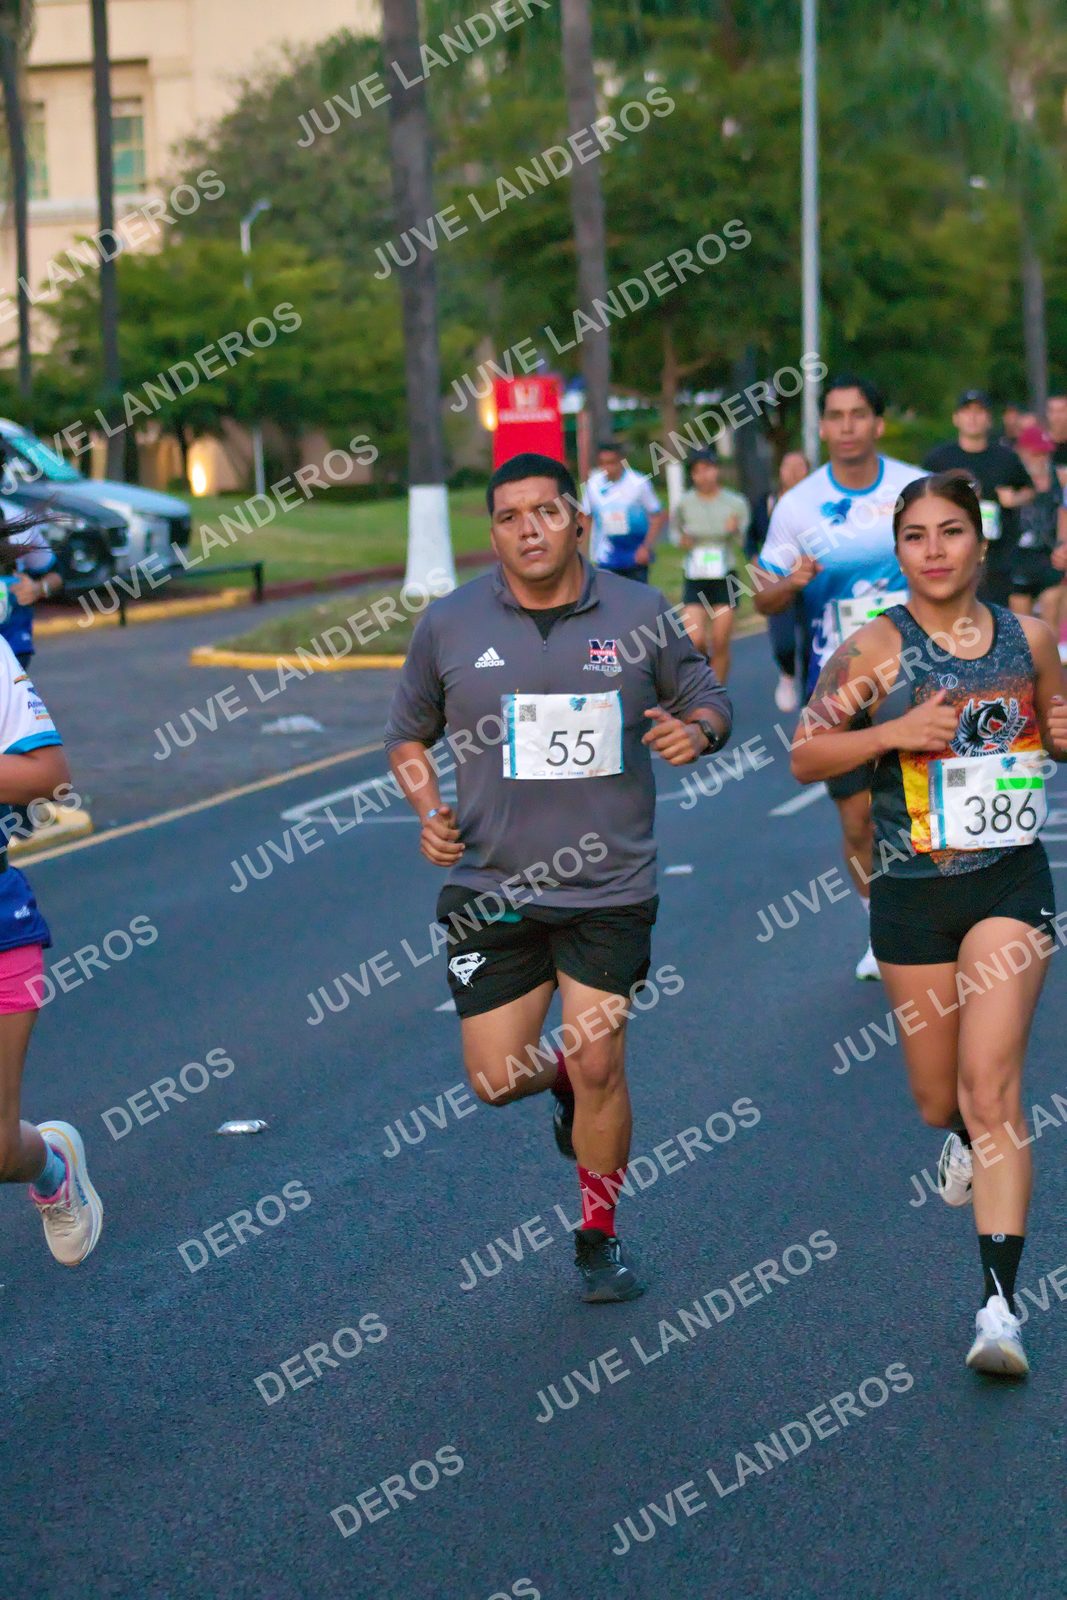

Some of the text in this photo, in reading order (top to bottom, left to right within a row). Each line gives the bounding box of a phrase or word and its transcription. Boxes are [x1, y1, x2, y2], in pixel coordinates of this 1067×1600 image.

[474, 659, 505, 669] adidas
[582, 663, 623, 673] ATHLETICS
[546, 730, 596, 767] 55
[964, 792, 1037, 836] 386
